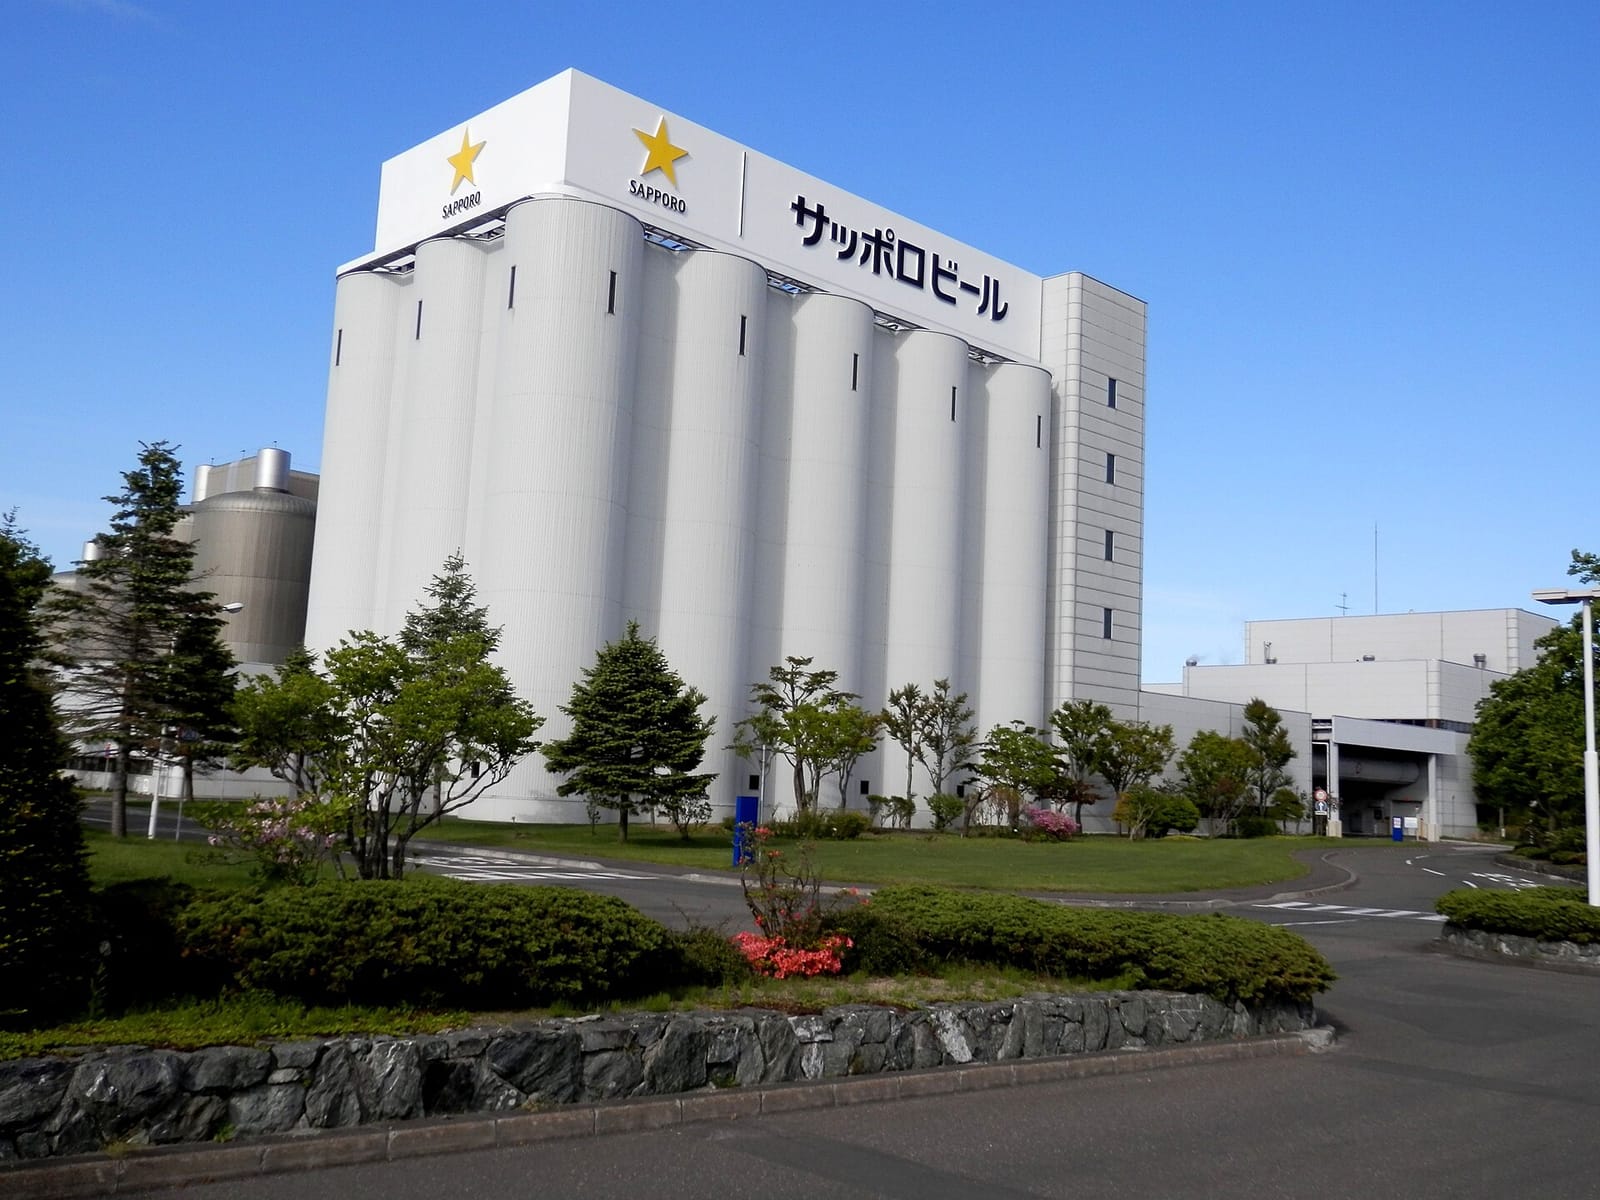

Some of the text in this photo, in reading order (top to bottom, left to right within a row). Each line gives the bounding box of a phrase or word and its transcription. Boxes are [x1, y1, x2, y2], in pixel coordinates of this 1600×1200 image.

[442, 191, 481, 219] SAPPORO
[630, 179, 686, 213] SAPPORO
[791, 195, 1008, 321] サッポロビール
